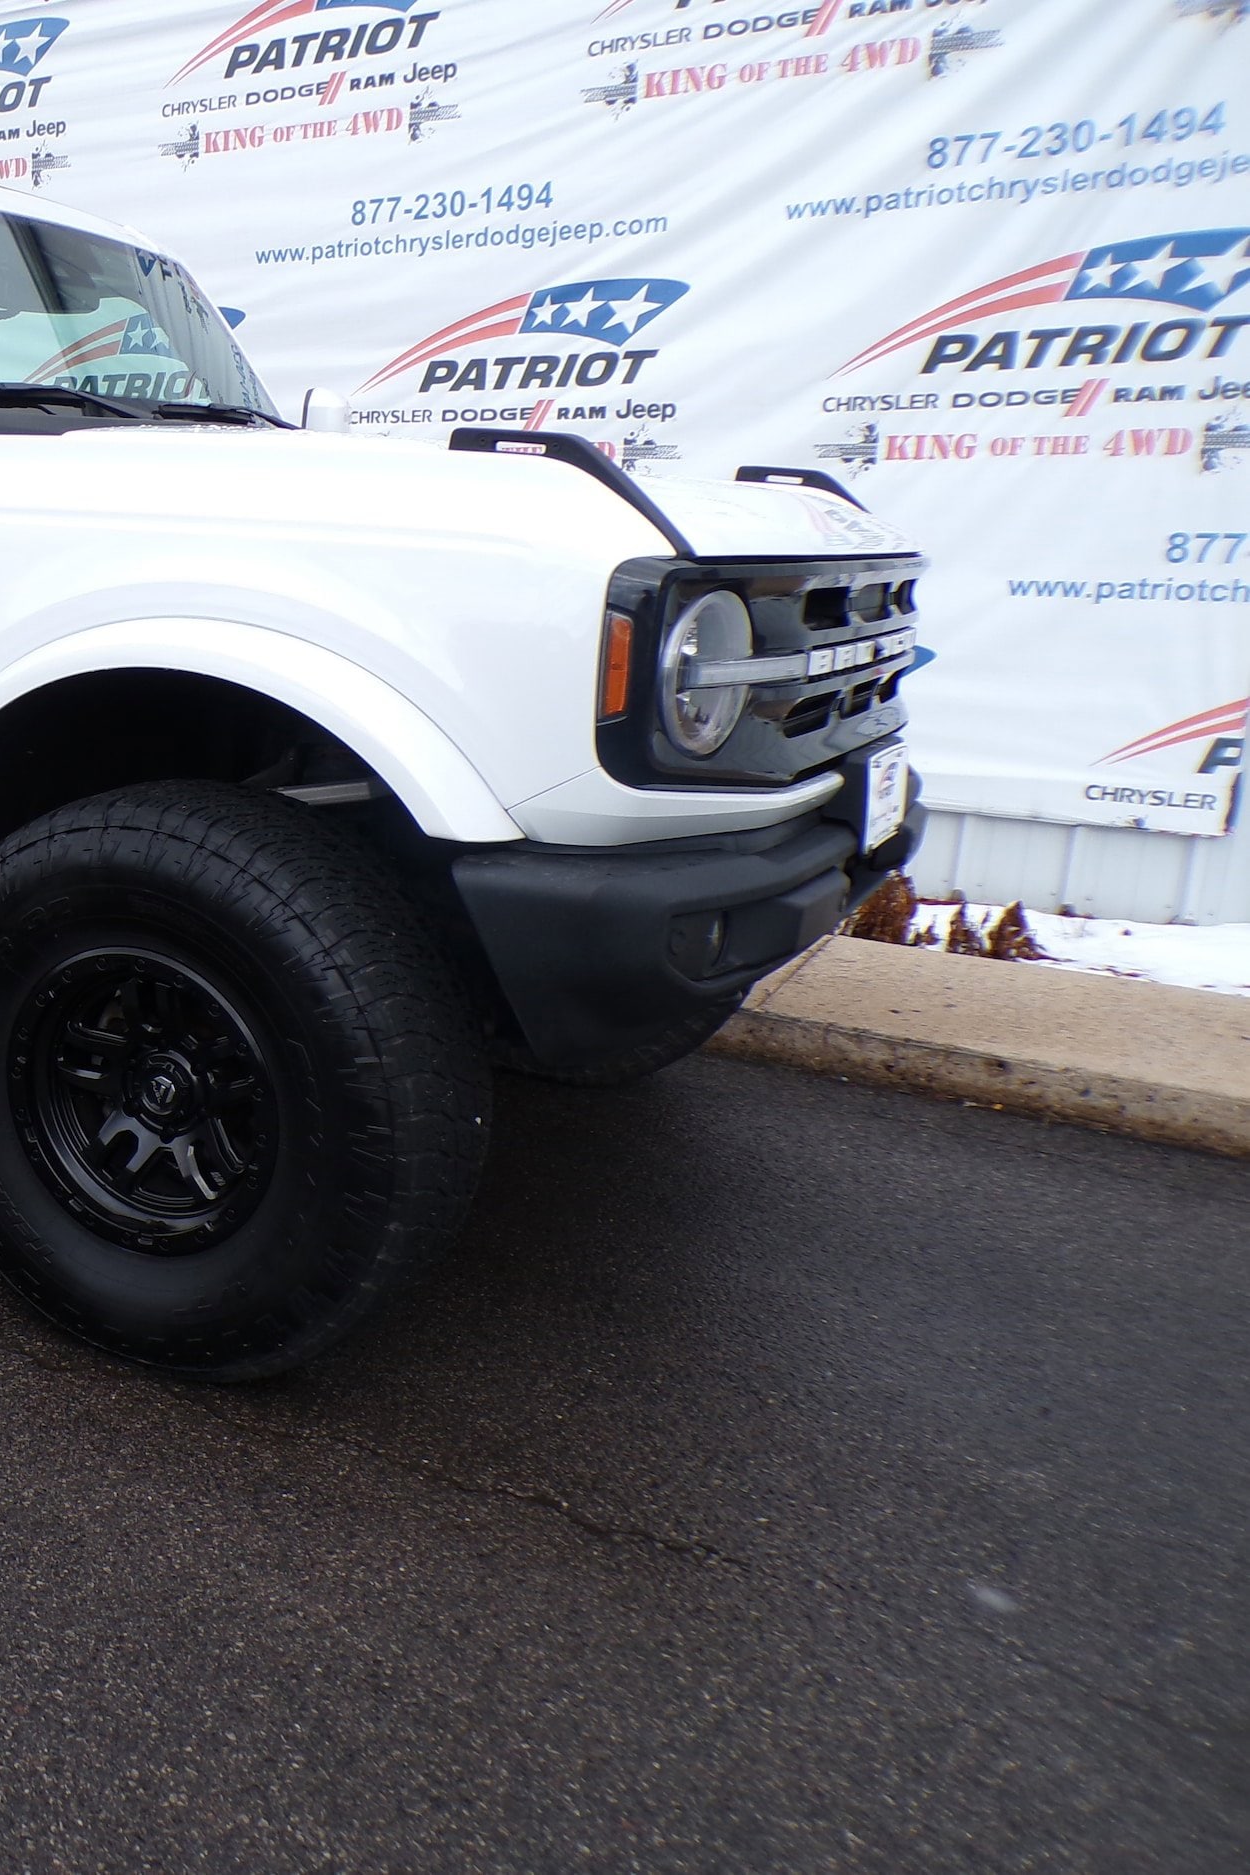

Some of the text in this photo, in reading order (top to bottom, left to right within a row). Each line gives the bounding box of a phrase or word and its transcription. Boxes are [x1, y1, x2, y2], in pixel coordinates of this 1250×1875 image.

[224, 10, 441, 79] PATRIOT
[587, 0, 913, 57] CHRYSLER DODGE RAM
[162, 62, 458, 117] CHRYSLER DODGE RAM Jeep
[644, 36, 922, 99] KING OF THE 4WD
[26, 120, 66, 137] Jeep
[204, 108, 403, 155] KING OF THE 4WD
[926, 101, 1227, 170] 877-230-1494
[351, 182, 554, 226] 877-230-1494
[255, 214, 668, 265] www.patriotchryslerdodgejeep.com
[918, 315, 1250, 374] PATRIOT
[419, 349, 659, 393] PATRIOT
[351, 398, 677, 425] CHRYSLER DODGE RAM Jeep
[822, 394, 938, 413] CHRYSLER
[951, 388, 1081, 408] DODGE
[1113, 385, 1185, 403] RAM
[884, 427, 1194, 461] KING OF THE 4WD
[1165, 532, 1250, 564] 877
[1085, 784, 1217, 811] CHRYSLER
